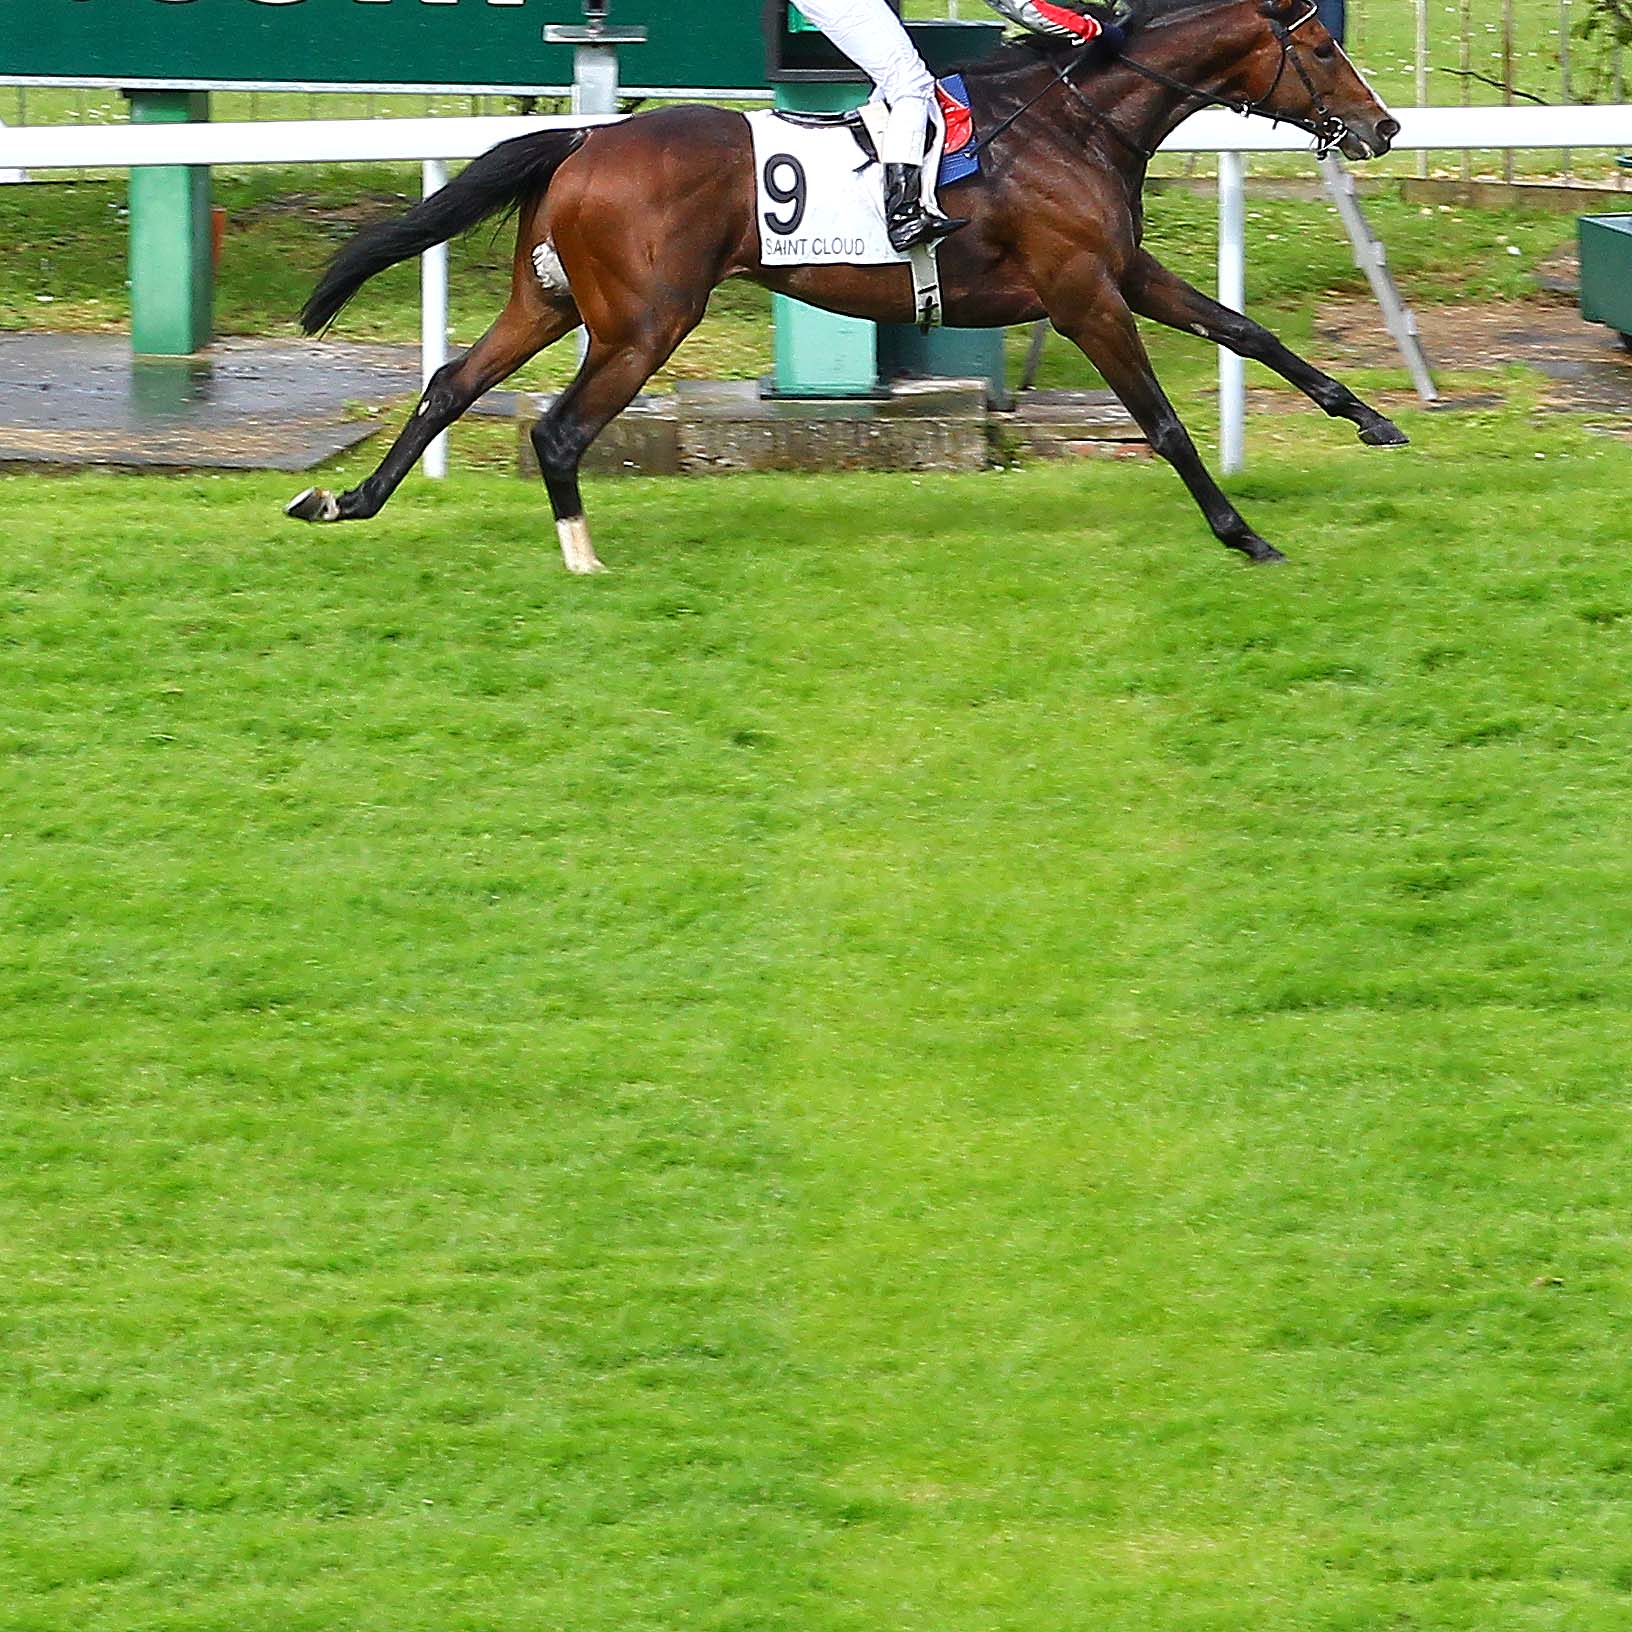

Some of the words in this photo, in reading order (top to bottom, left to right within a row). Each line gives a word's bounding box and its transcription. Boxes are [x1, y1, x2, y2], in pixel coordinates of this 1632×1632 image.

[763, 153, 807, 235] 9
[765, 237, 808, 256] SAINT
[811, 237, 865, 256] CLOUD
